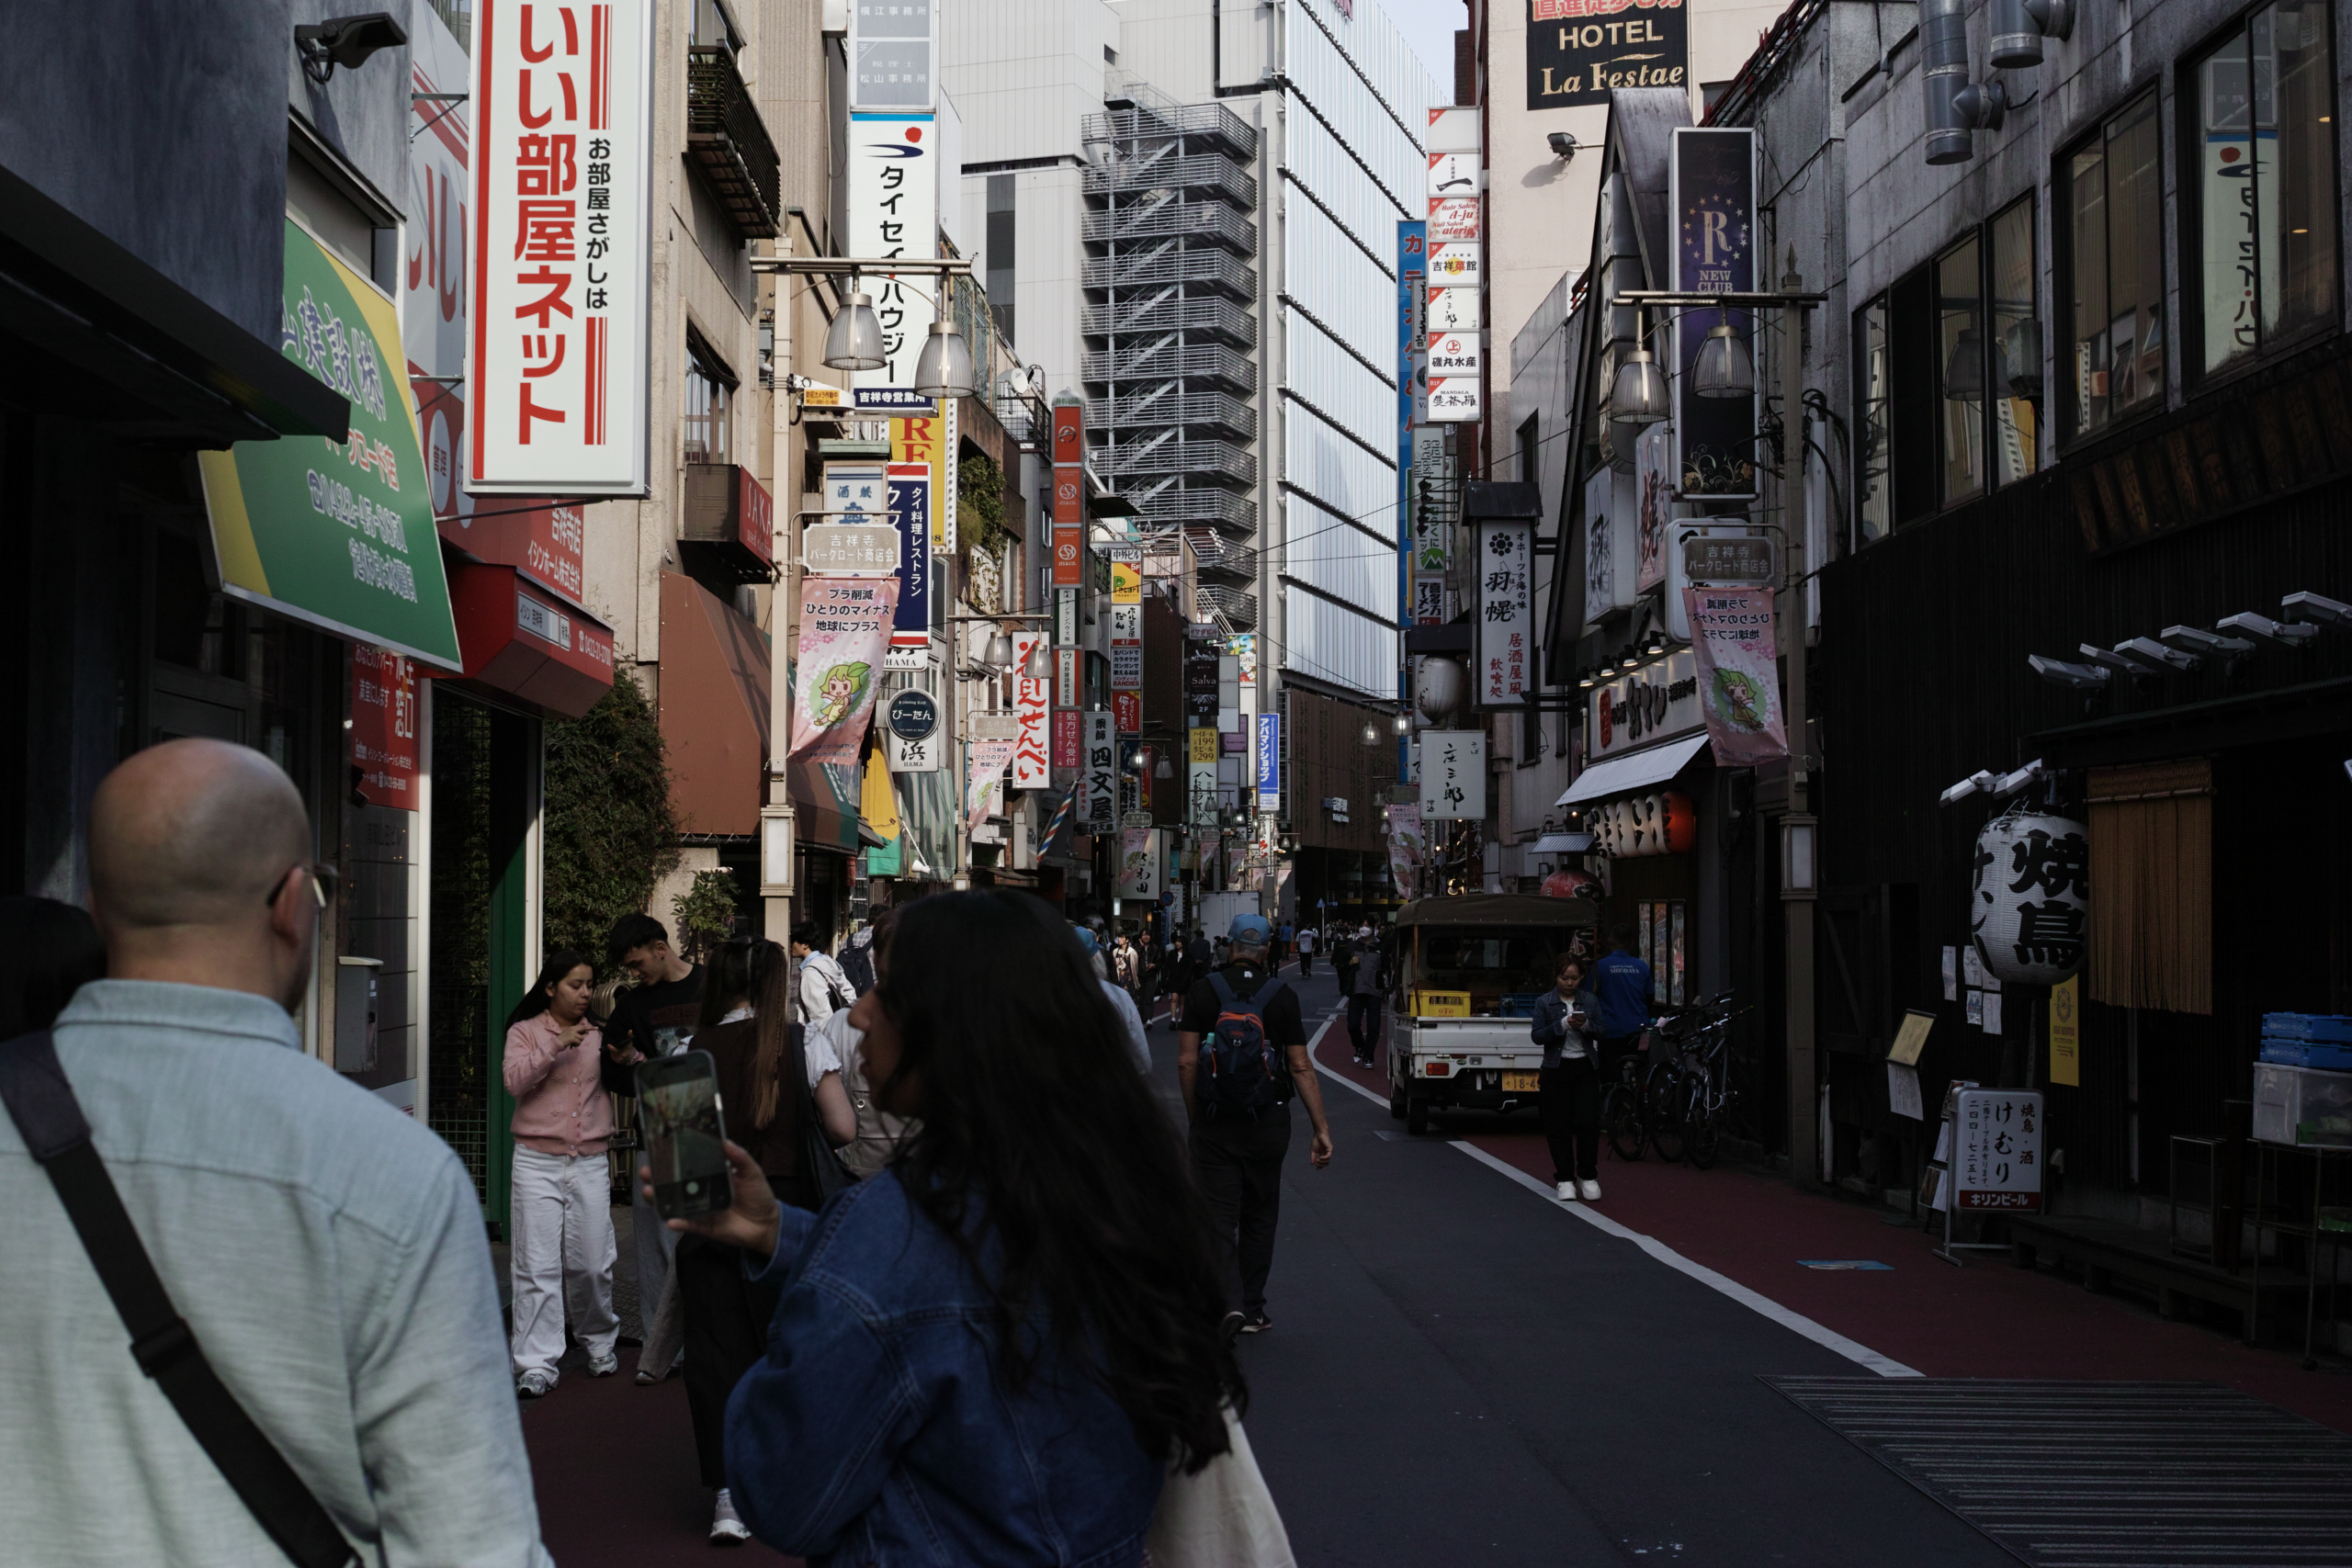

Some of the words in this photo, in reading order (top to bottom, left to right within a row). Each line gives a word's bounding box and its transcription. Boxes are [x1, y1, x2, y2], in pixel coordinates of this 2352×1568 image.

[1559, 19, 1664, 50] HOTEL
[860, 73, 927, 84] 松山事務所
[1541, 67, 1581, 96] La
[1589, 61, 1684, 91] Festae
[515, 4, 579, 446] いい部屋ネット
[585, 137, 611, 309] お部屋さがしは
[1701, 211, 1733, 265] R
[1432, 261, 1476, 273] 吉祥菜館
[1700, 270, 1731, 281] NEW
[1697, 282, 1734, 293] CLUB
[1431, 356, 1476, 367] 磯丸水産
[859, 391, 926, 403] 吉祥寺営業所
[1431, 439, 1443, 467] eight
[830, 535, 876, 547] 吉祥寺
[910, 487, 923, 597] タイ料理レストラン
[809, 548, 895, 563] パークロード商店会
[1114, 549, 1139, 560] 中外ビル
[1707, 546, 1749, 558] 吉祥寺
[1516, 531, 1527, 610] オホーツク海の味
[1689, 558, 1769, 573] パークロード商店会
[829, 589, 874, 601] プラ削減
[1419, 582, 1430, 615] ラーメン
[1430, 582, 1442, 615] 喜多方
[1485, 570, 1511, 623] 羽幌
[806, 604, 890, 616] ひとりのマイナス
[816, 620, 879, 632] 地球にプラス
[1508, 633, 1523, 695] 居酒屋風
[1192, 674, 1216, 685] Salva
[892, 709, 933, 721] びーたん
[1066, 712, 1077, 766] 処方せん受付
[900, 741, 926, 761] 浜
[1260, 717, 1271, 783] アパマンショップ
[1089, 746, 1114, 819] 四文屋
[2008, 829, 2089, 971] 焼鳥
[1513, 1078, 1540, 1089] 18-4
[1995, 1101, 2013, 1185] けむり
[2019, 1102, 2035, 1165] 焼鳥・酒
[1971, 1193, 2029, 1207] キリンビール
